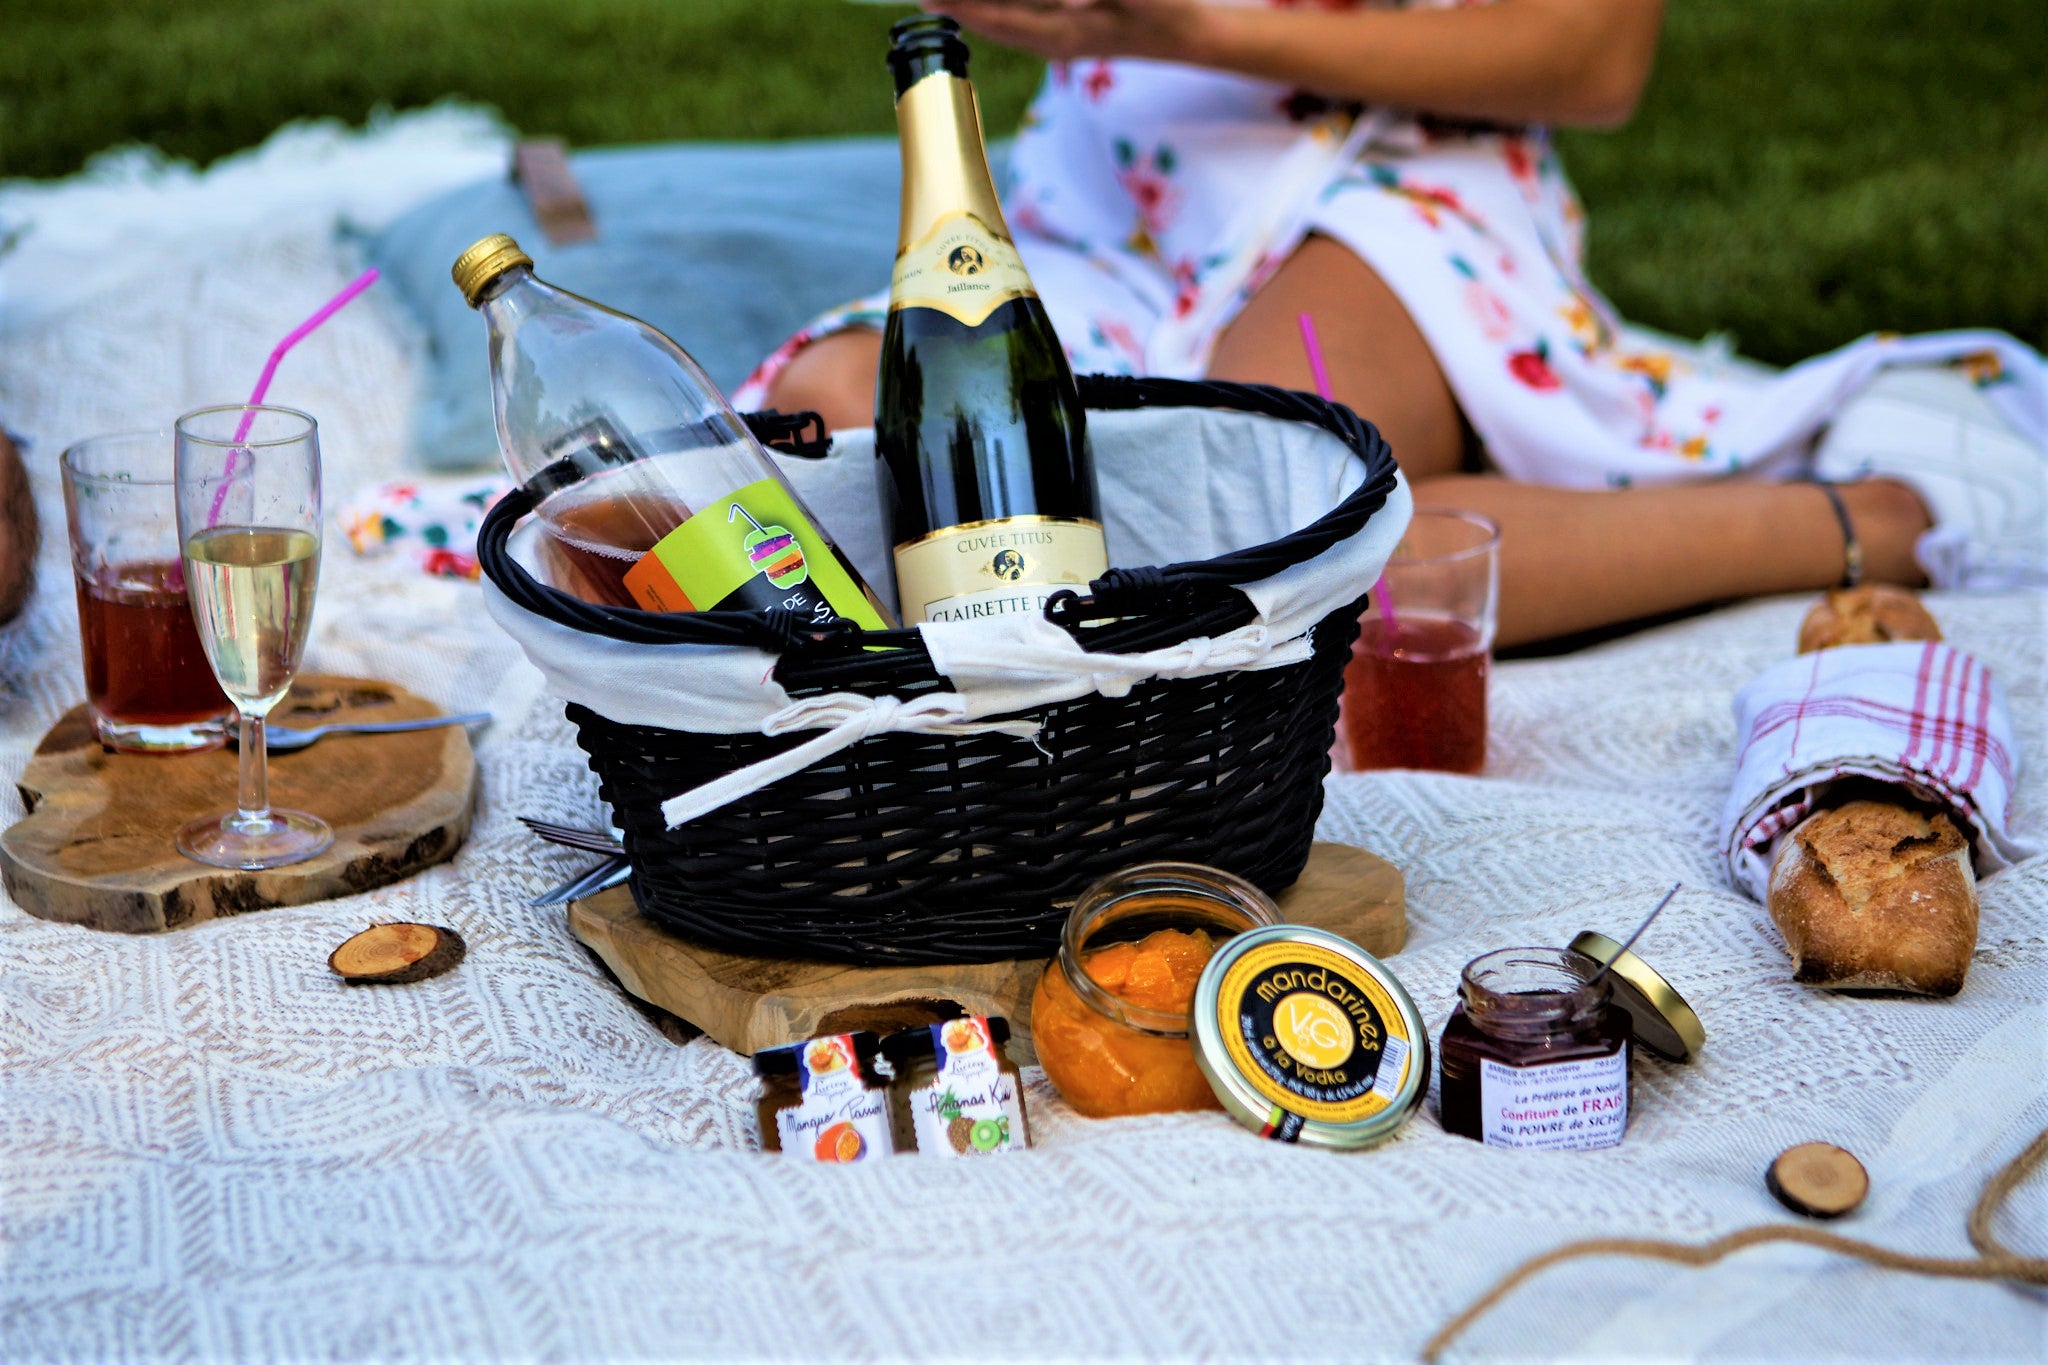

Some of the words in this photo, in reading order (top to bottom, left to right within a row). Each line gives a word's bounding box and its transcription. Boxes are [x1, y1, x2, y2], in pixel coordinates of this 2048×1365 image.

[946, 282, 991, 294] Jaillance
[1011, 532, 1053, 545] TITUS
[782, 592, 807, 611] DE
[932, 597, 1031, 623] CLAIRETTE
[1256, 969, 1380, 1053] mandarines
[1515, 1094, 1528, 1104] La
[1579, 1086, 1593, 1097] de
[925, 1091, 986, 1126] Ananas
[1501, 1107, 1559, 1122] Confiture
[1563, 1105, 1578, 1116] de
[1501, 1125, 1514, 1135] au
[1518, 1121, 1566, 1137] POIVRE
[1569, 1119, 1584, 1131] de
